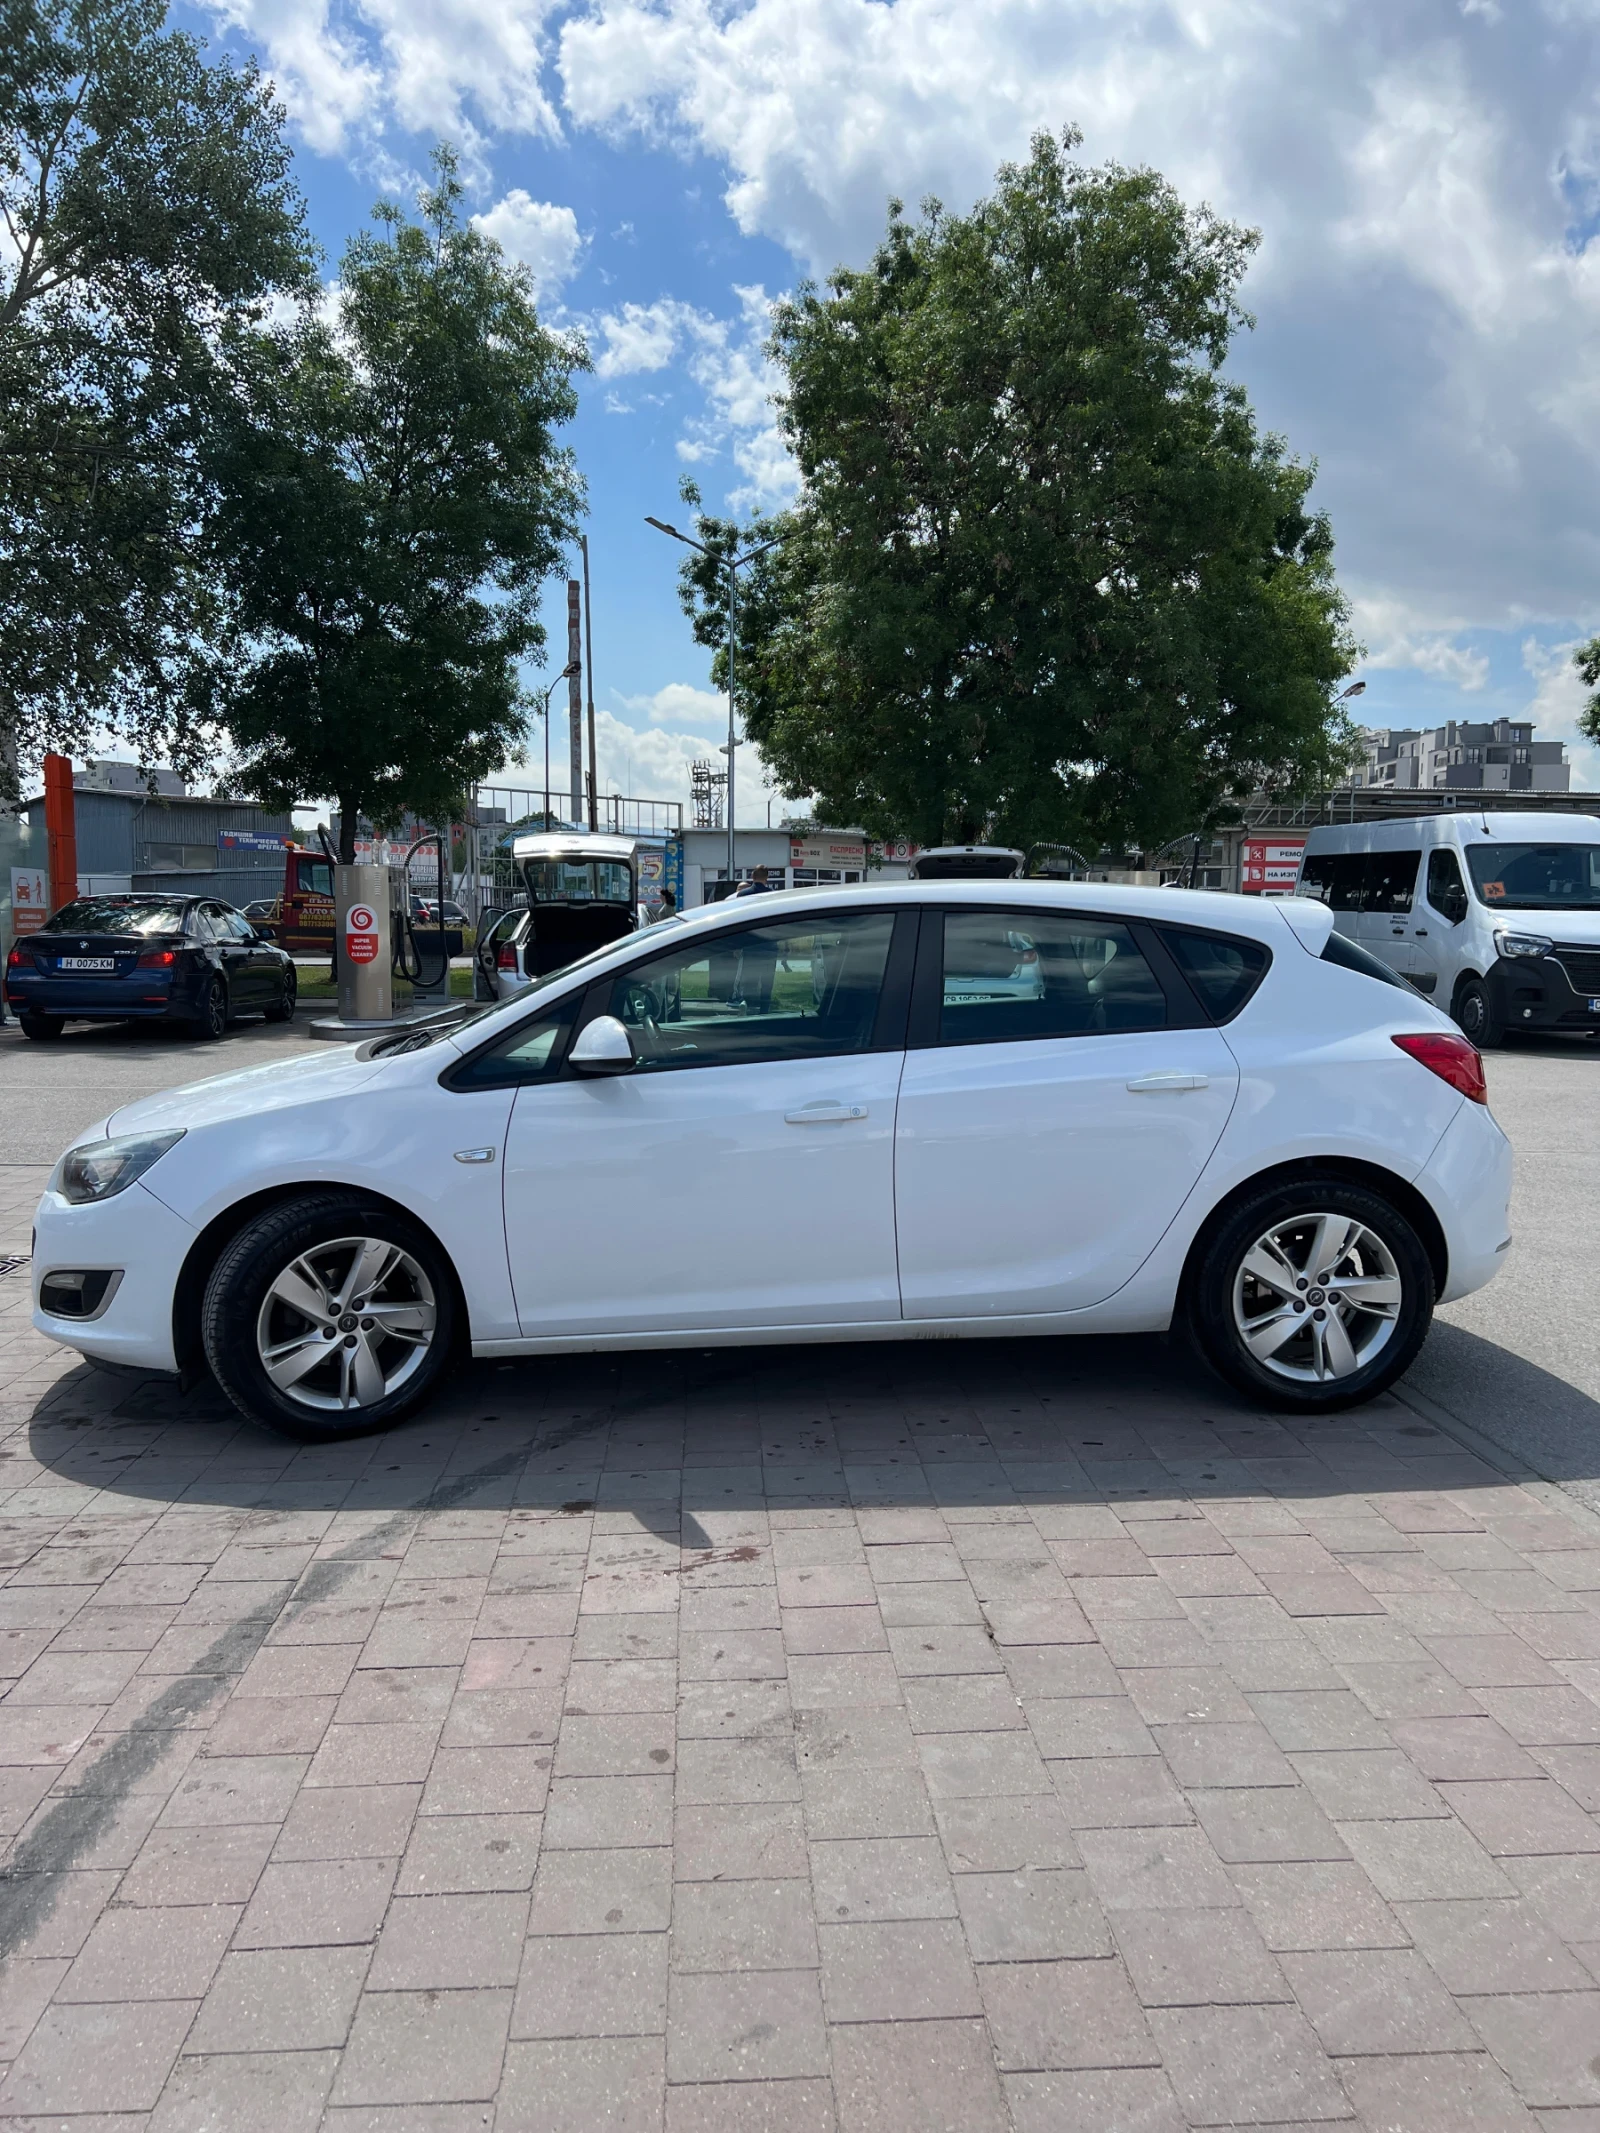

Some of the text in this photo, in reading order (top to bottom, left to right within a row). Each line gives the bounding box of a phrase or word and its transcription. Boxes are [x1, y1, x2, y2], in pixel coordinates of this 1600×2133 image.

[220, 830, 253, 838] ГОДИШНИ
[238, 837, 279, 845] ТЕХНИЧЕСКИ
[830, 845, 864, 855] ЕКСПРЕСНО
[302, 907, 328, 915] AUTO
[65, 959, 113, 968] H 0075 KM
[1333, 1189, 1408, 1235] MICHELIN
